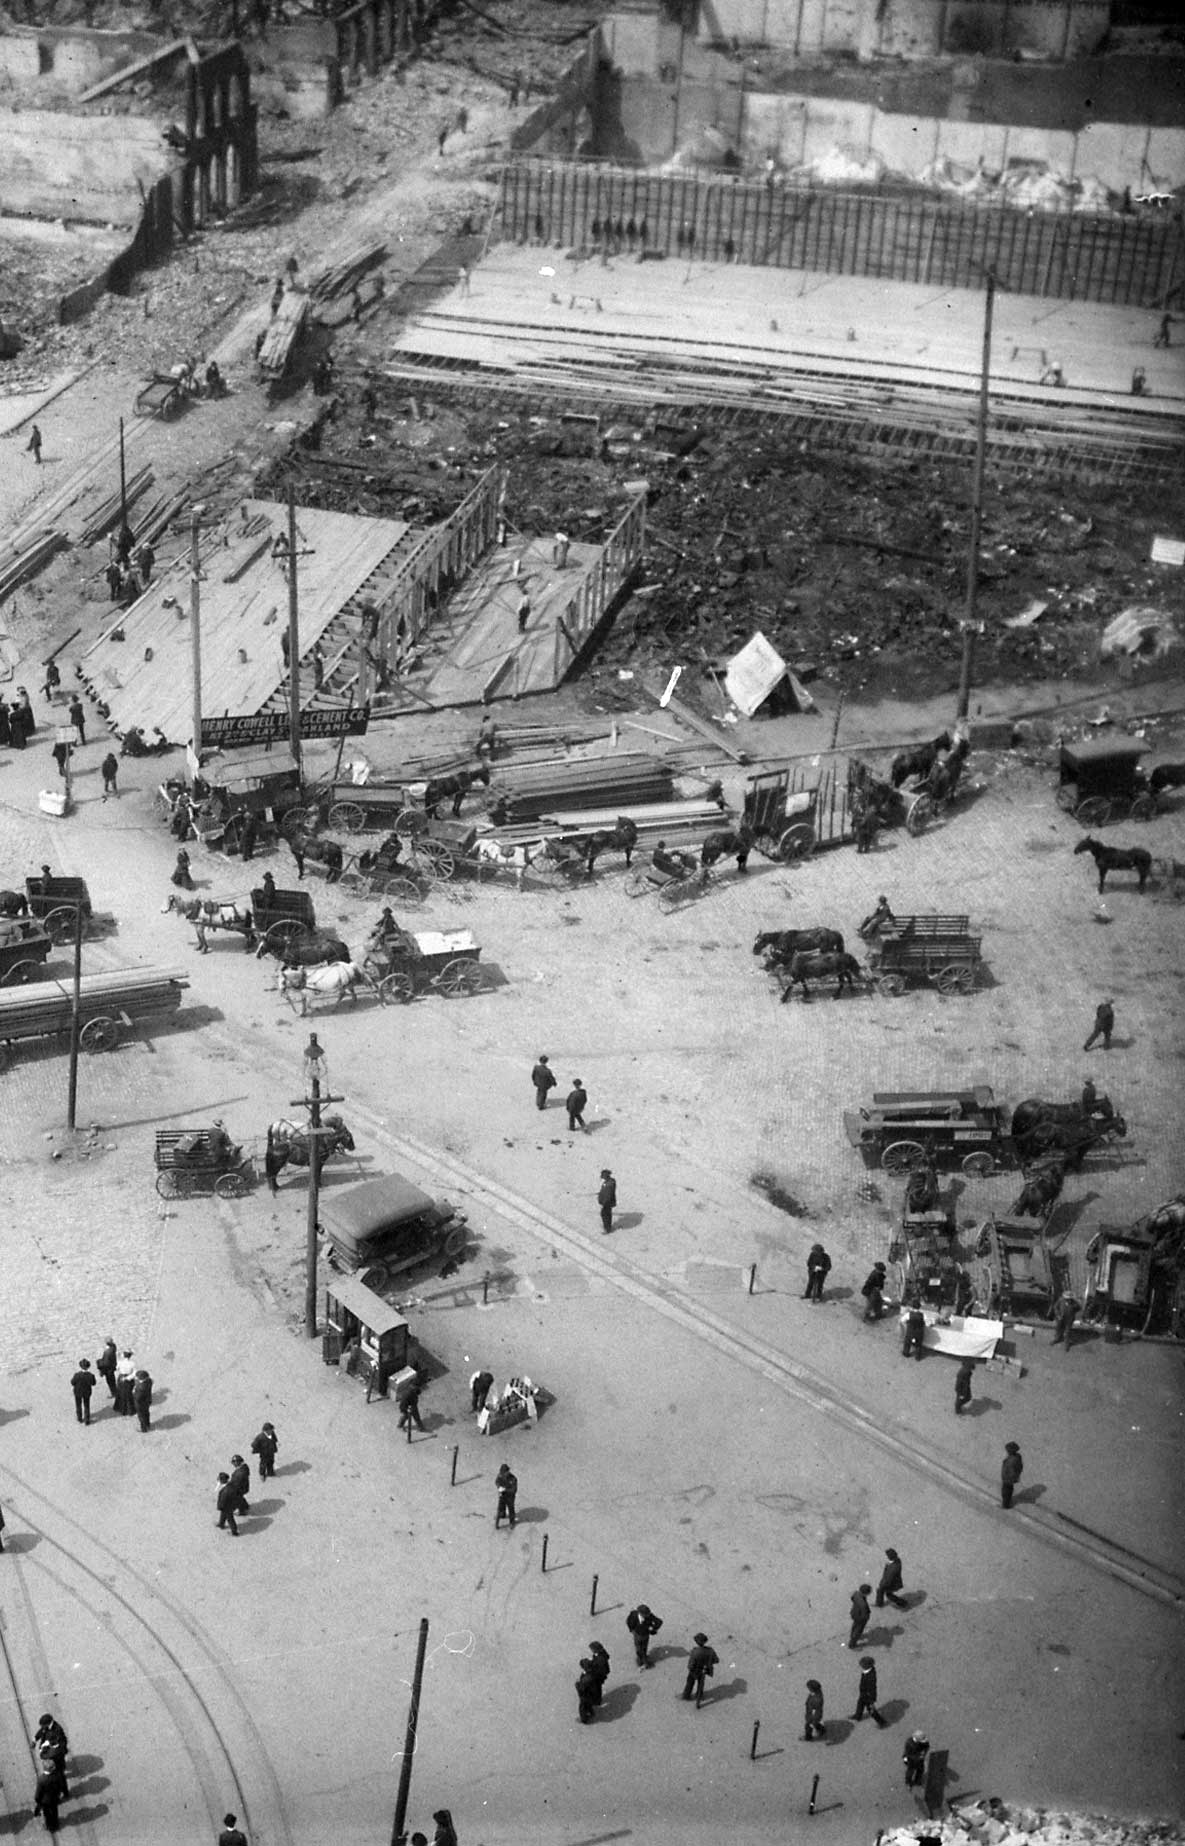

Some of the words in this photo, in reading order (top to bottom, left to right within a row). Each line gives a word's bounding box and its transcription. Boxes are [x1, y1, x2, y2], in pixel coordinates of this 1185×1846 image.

[202, 719, 236, 731] HENRY
[237, 716, 275, 729] COWELL
[310, 711, 348, 724] CEMENT
[350, 710, 366, 721] CO.
[300, 722, 351, 733] AKLAND
